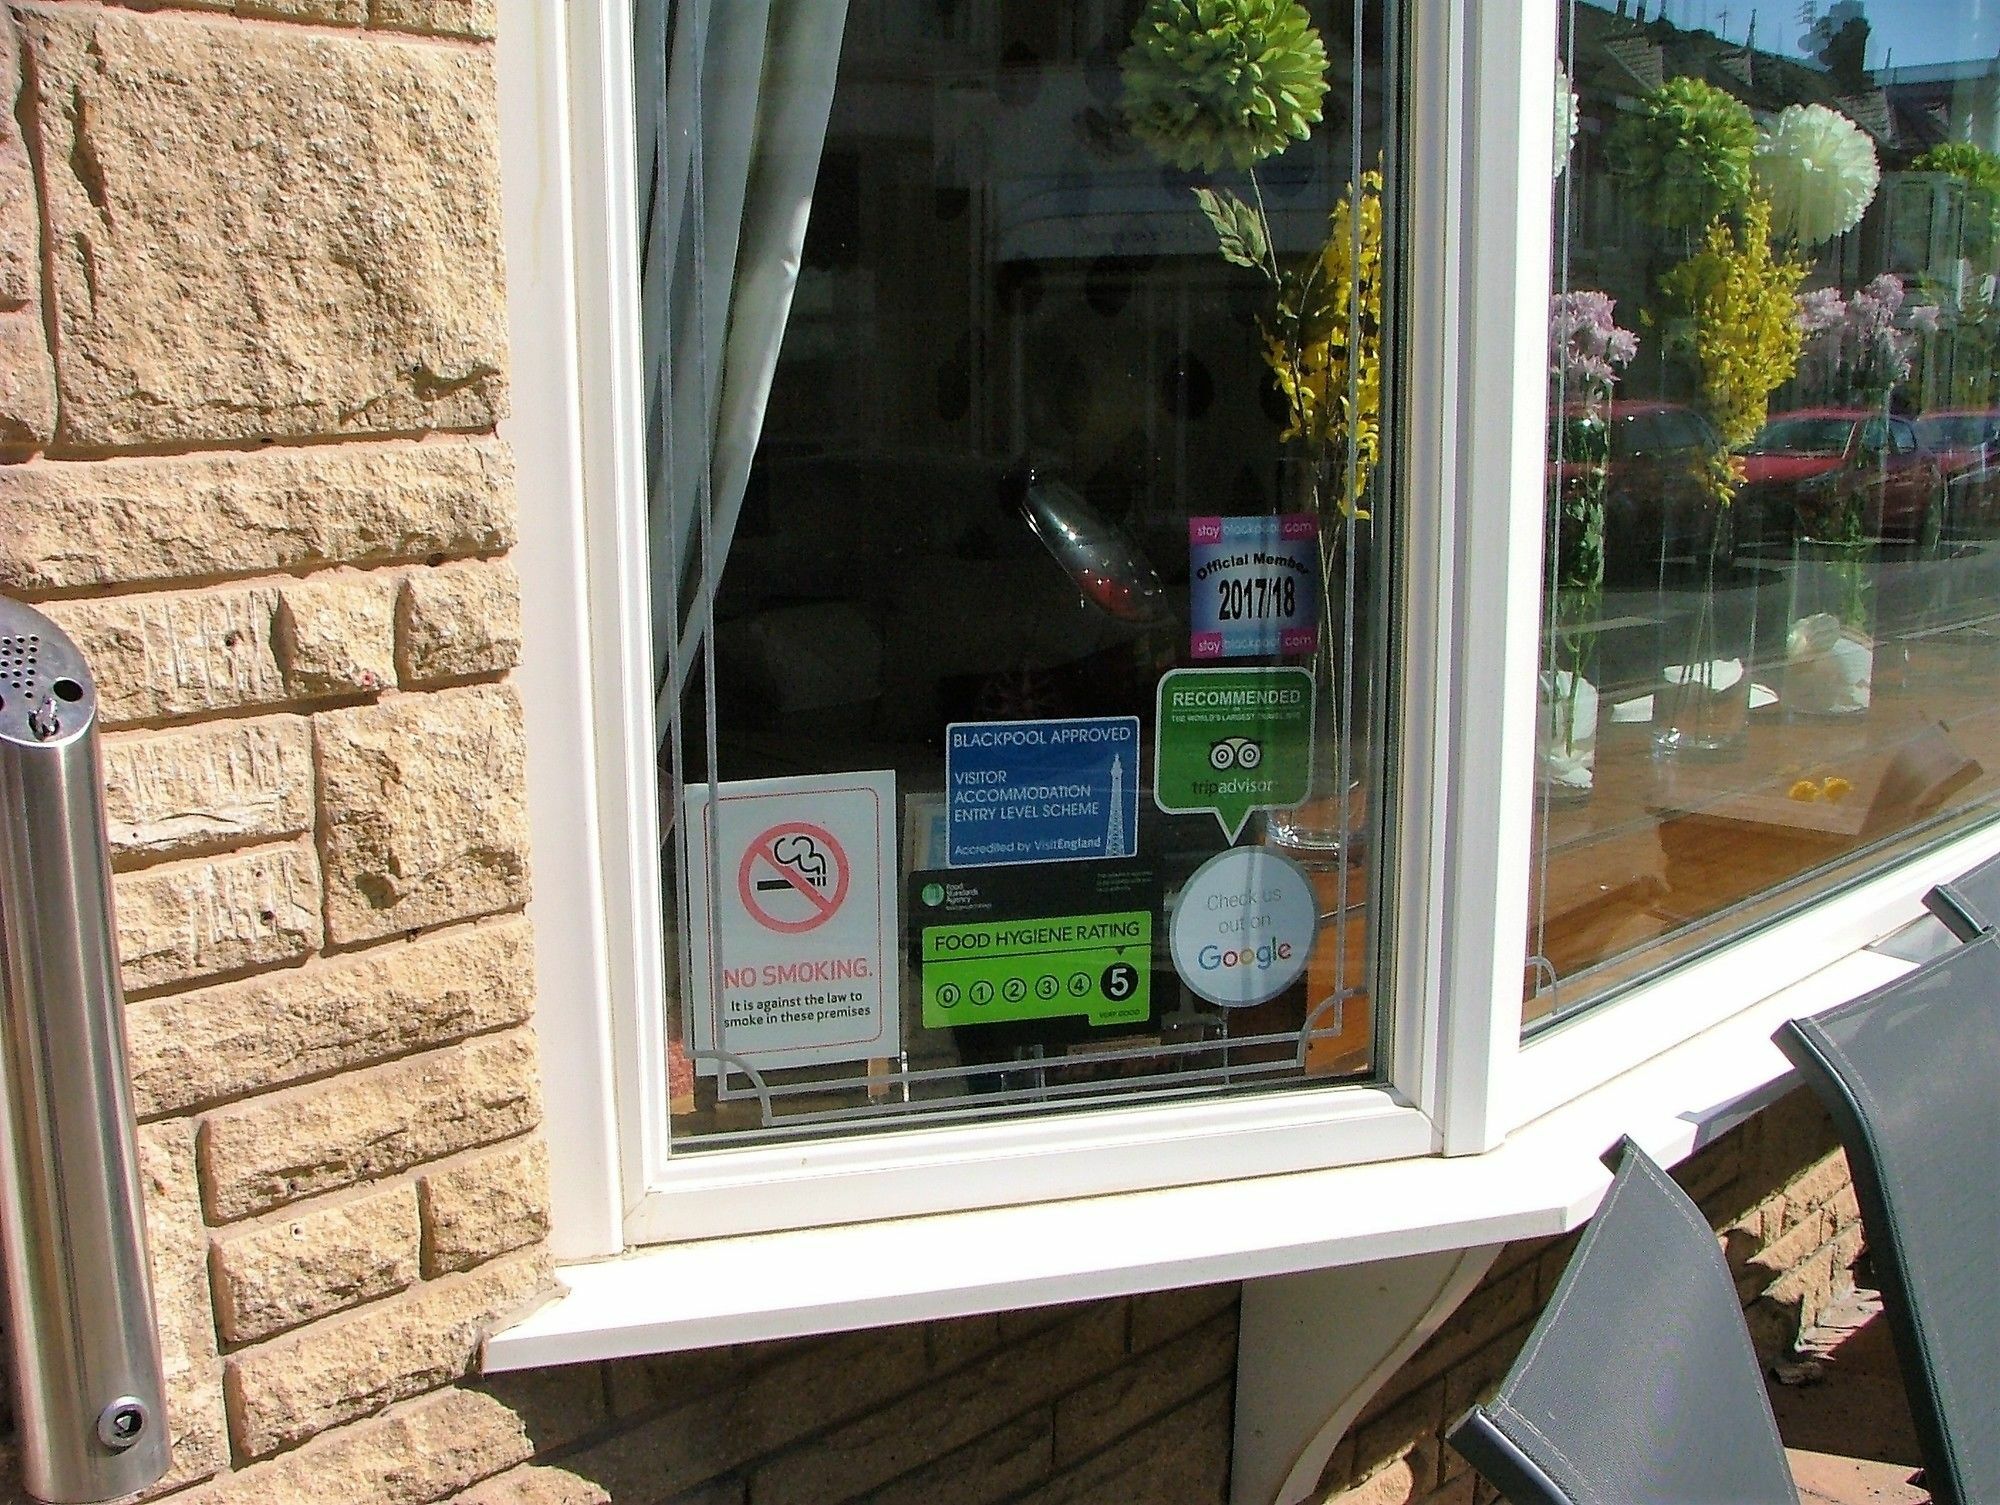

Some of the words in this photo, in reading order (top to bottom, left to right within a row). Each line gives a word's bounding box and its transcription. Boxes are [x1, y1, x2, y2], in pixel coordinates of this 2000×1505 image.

[1196, 553, 1249, 581] Official
[1253, 552, 1310, 576] Member
[1218, 576, 1296, 621] 2017/18
[1173, 690, 1301, 706] RECOMMENDED
[953, 730, 1047, 748] BLACKPOOL
[1050, 726, 1131, 745] APPROVED
[954, 770, 1008, 785] VISITOR
[1192, 778, 1274, 797] tripadvisor
[954, 784, 1091, 804] ACCOMMODATION
[954, 808, 996, 823] ENTRY
[1000, 804, 1039, 820] LEVEL
[1042, 801, 1100, 818] SCHEME
[954, 841, 1015, 855] Accredited
[1017, 841, 1031, 852] by
[1207, 890, 1258, 911] Check
[1263, 888, 1282, 902] us
[935, 933, 991, 951] FOOD
[995, 925, 1073, 947] HYGIENE
[1076, 920, 1140, 939] RATING
[1218, 918, 1246, 934] out
[1251, 914, 1272, 929] on
[1198, 935, 1292, 971] Google
[723, 966, 757, 988] NO
[763, 957, 873, 986] SMOKING.
[942, 988, 955, 1003] 0
[976, 986, 986, 1001] 1
[1009, 982, 1020, 998] 2
[1042, 979, 1053, 995] 3
[1073, 976, 1085, 992] 4
[1110, 967, 1129, 997] 5
[731, 999, 742, 1012] It
[743, 999, 754, 1011] is
[756, 993, 802, 1014] against
[804, 991, 824, 1006] the
[826, 991, 848, 1005] law
[850, 991, 863, 1003] to
[724, 1014, 764, 1029] smoke
[766, 1012, 778, 1025] in
[780, 1010, 814, 1024] these
[816, 1006, 872, 1024] premises
